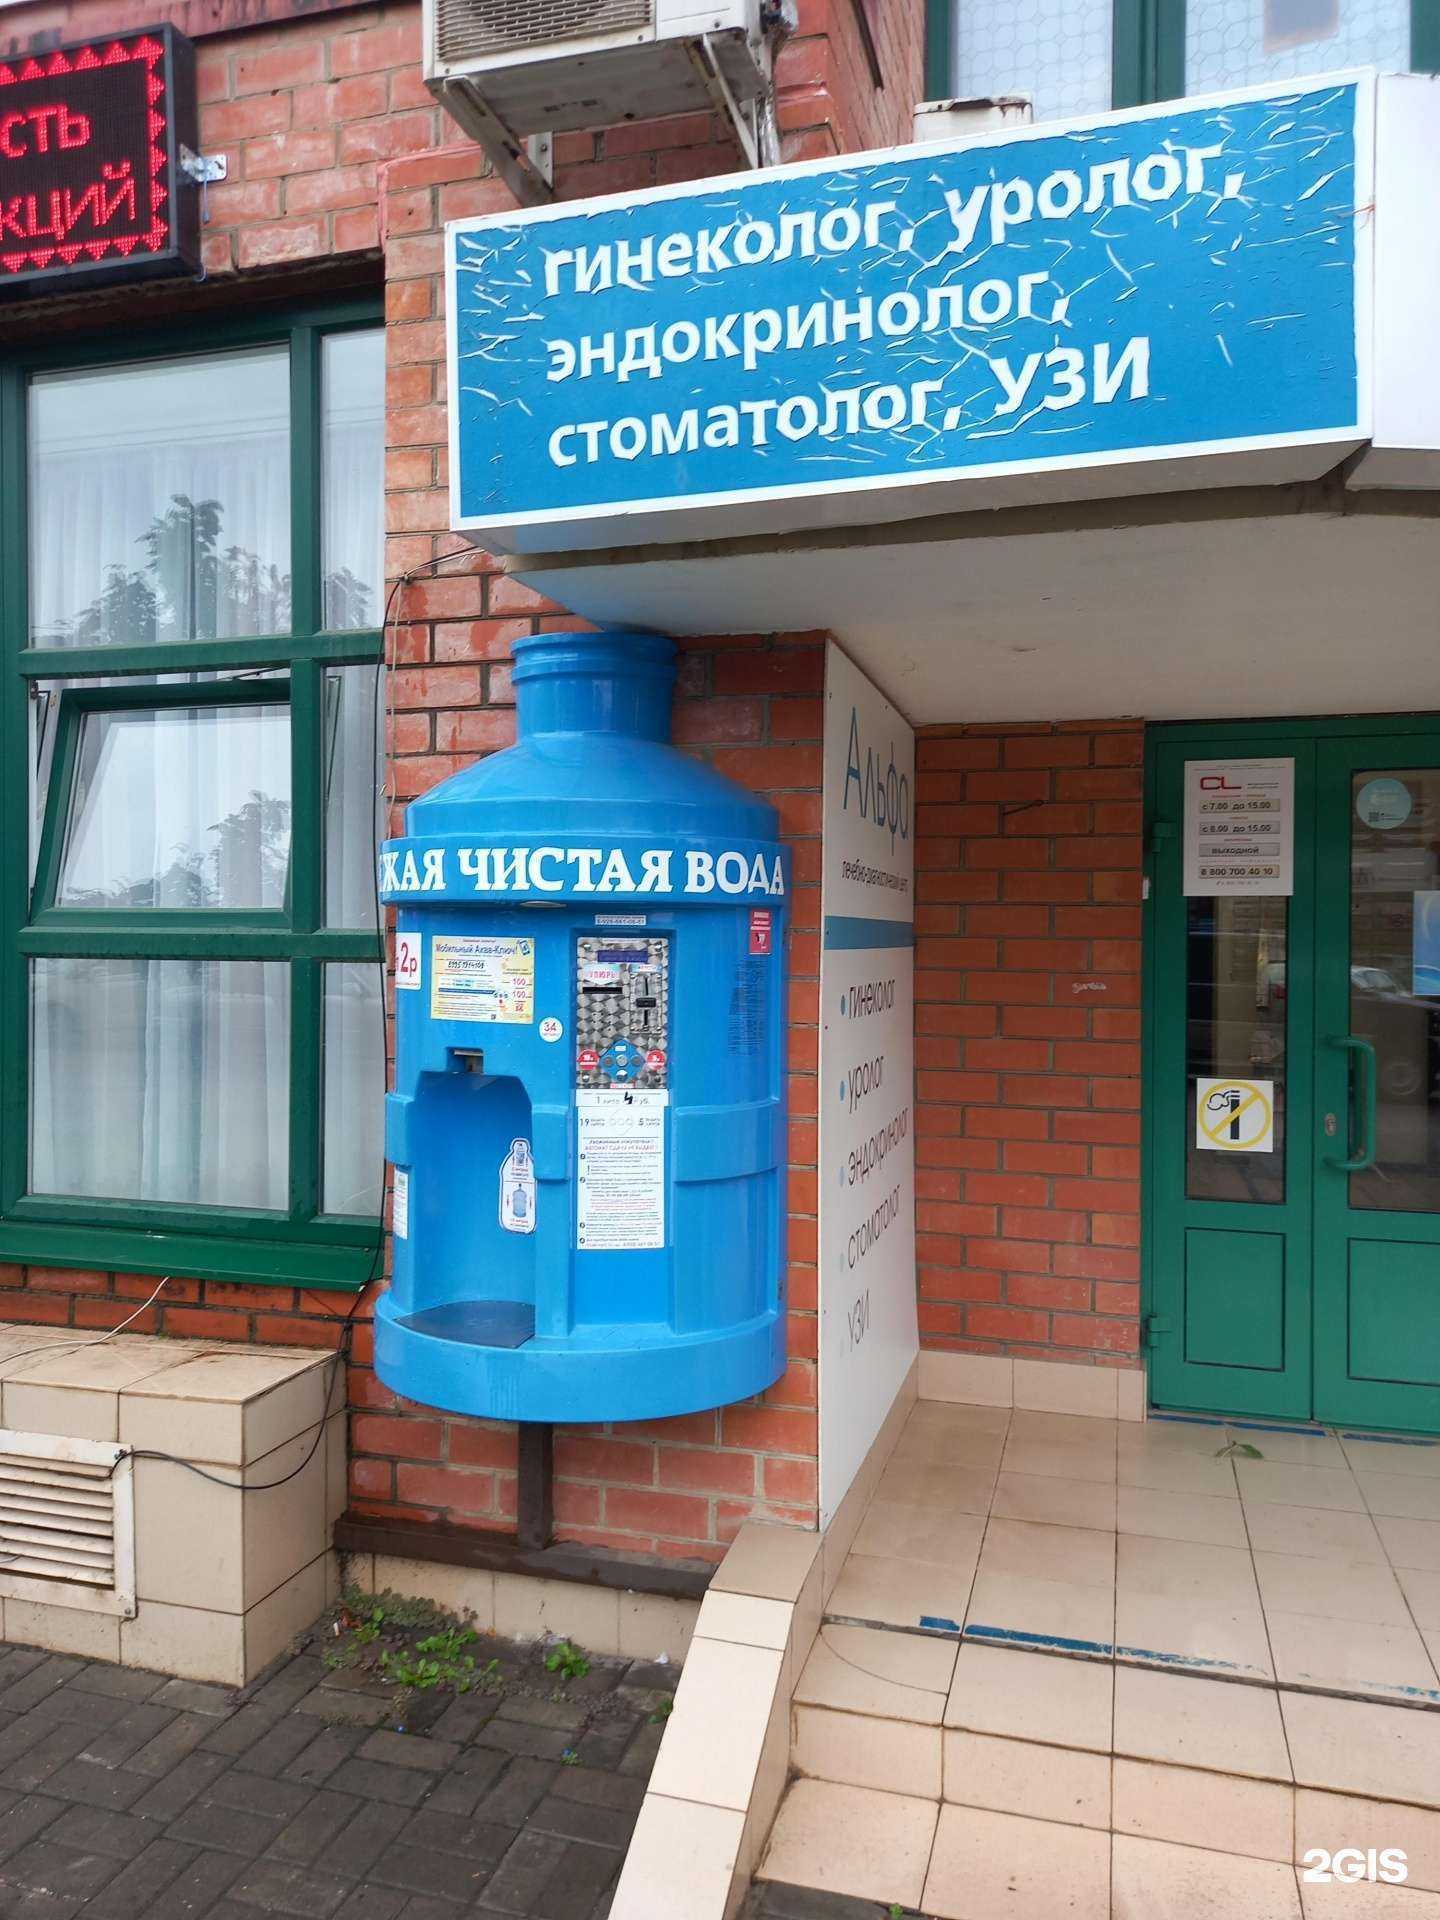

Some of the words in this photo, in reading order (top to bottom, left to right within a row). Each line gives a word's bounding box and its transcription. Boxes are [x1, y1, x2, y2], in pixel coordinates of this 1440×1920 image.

[543, 200, 915, 297] гинеколог,
[944, 138, 1244, 247] уролог,
[545, 269, 1070, 383] эндокринолог,
[546, 377, 960, 469] стоматолог,
[995, 335, 1153, 419] УЗИ
[457, 846, 674, 894] ЧИСТАЯ
[684, 851, 785, 895] ВОДА
[848, 1056, 884, 1114] уролог
